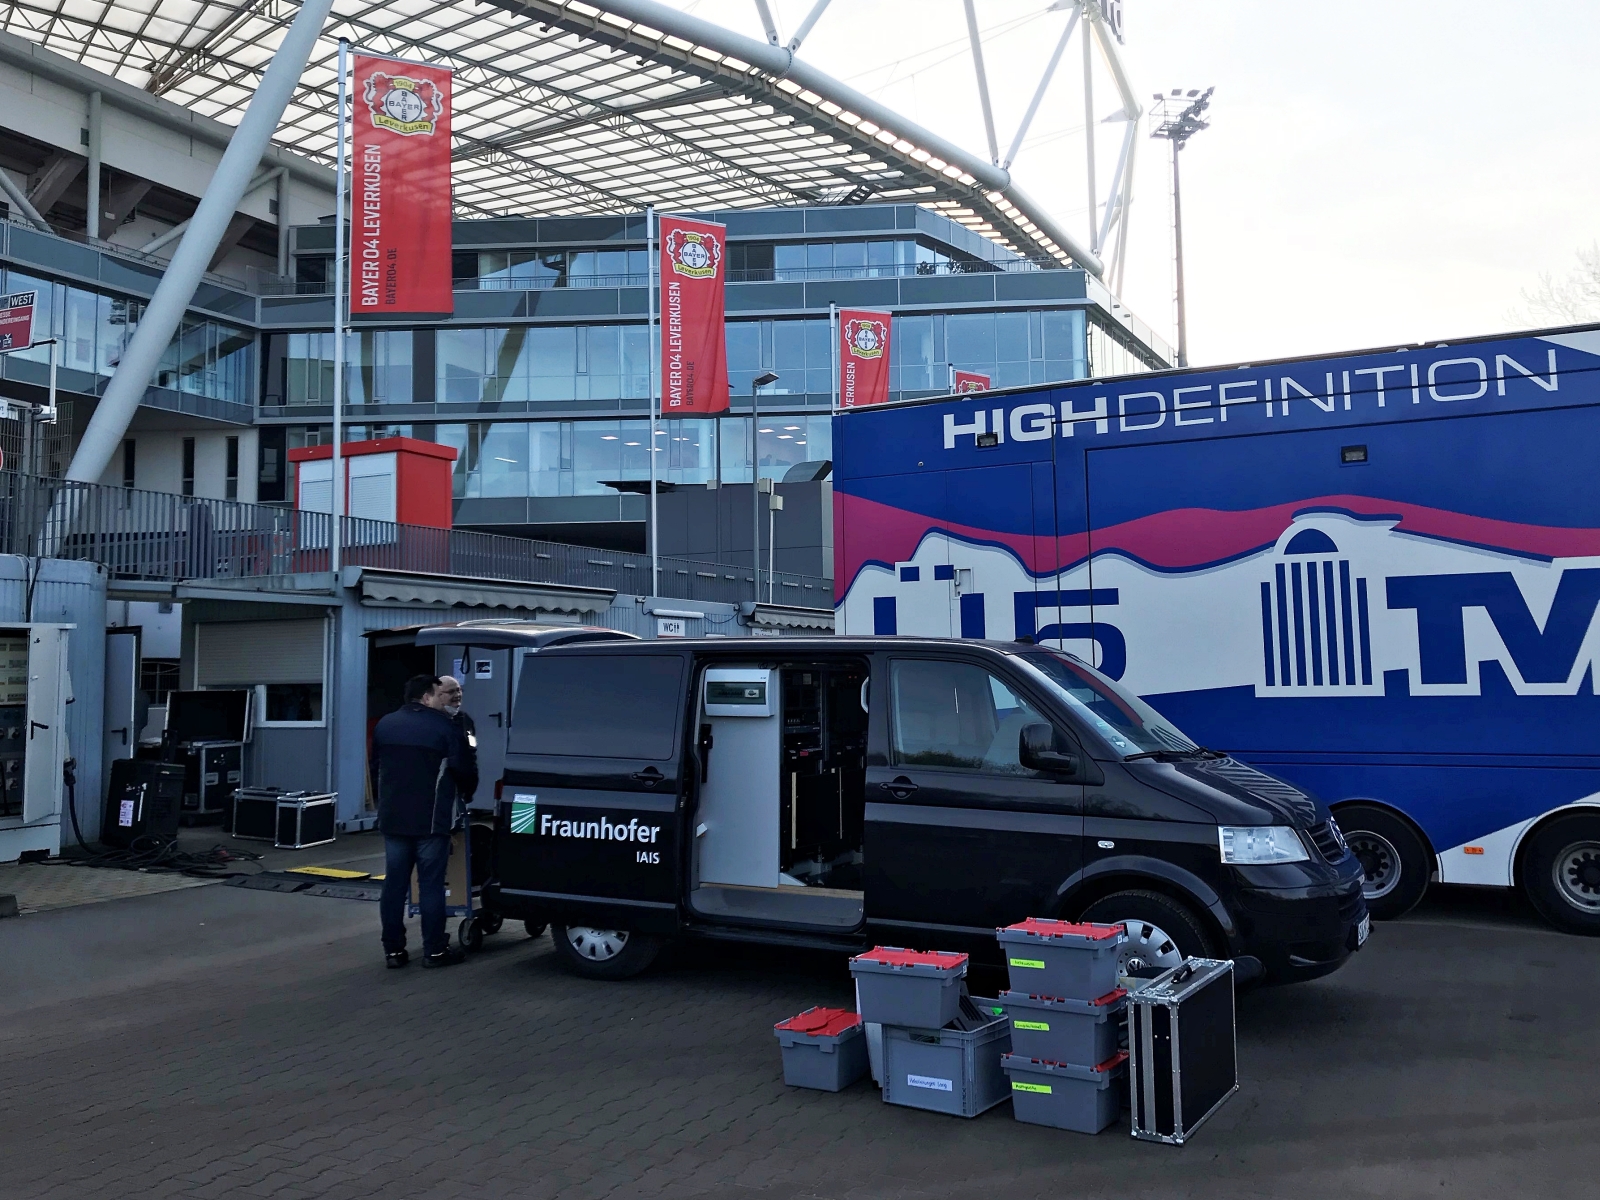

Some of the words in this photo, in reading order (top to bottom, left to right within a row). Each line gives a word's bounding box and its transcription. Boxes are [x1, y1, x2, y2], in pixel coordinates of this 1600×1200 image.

[388, 100, 420, 110] BAYER
[378, 116, 429, 132] Leverkusen
[363, 144, 381, 237] LEVERKUSEN
[362, 238, 380, 260] 04
[361, 260, 380, 306] BAYER
[384, 247, 398, 305] BAYER04.DE
[11, 294, 33, 306] WEST
[668, 281, 681, 352] LEVERKUSEN
[669, 353, 682, 370] 04
[669, 371, 682, 407] BAYER
[662, 622, 674, 633] WC
[540, 814, 661, 843] Fraunhofer
[636, 851, 661, 865] IAIS
